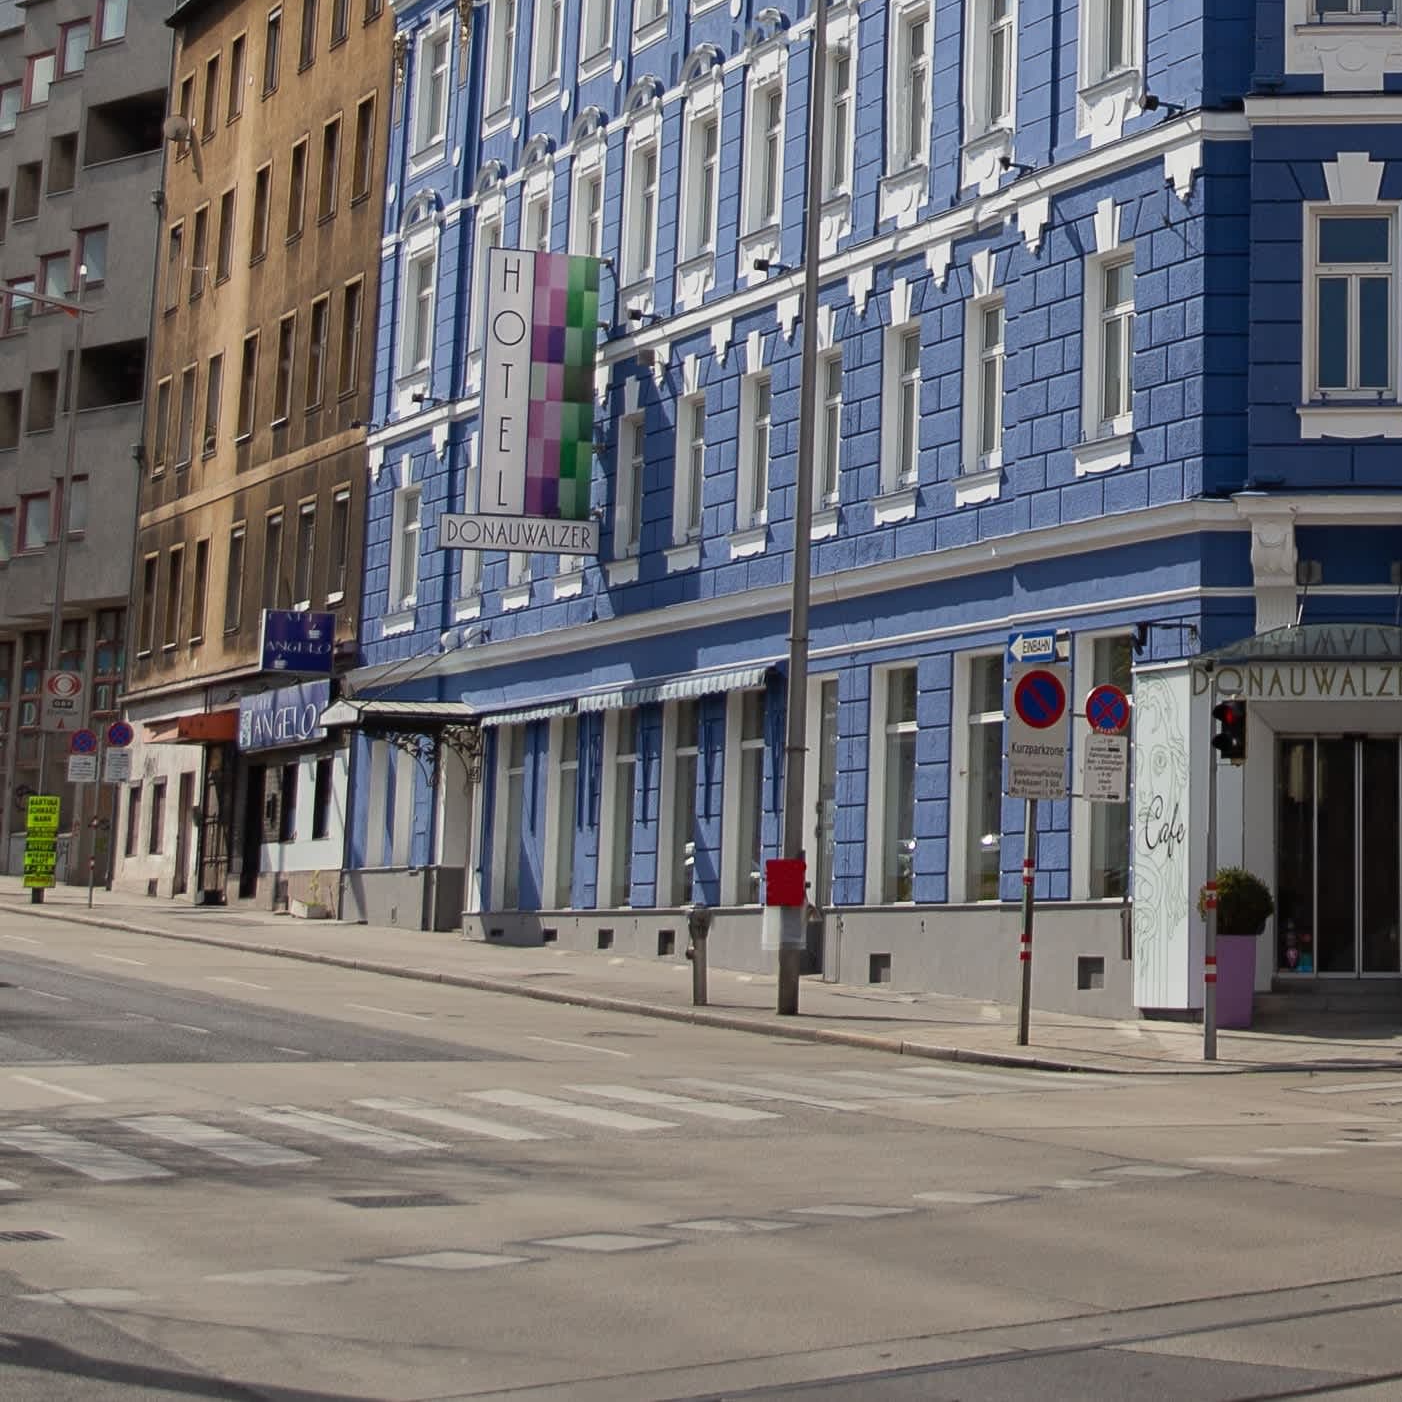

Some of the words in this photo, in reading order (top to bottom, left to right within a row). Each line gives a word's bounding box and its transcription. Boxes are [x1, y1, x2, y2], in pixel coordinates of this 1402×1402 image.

[493, 257, 526, 507] HOTEL
[447, 519, 592, 549] DONAUWALZER
[267, 641, 332, 654] ANGELO
[1023, 637, 1051, 654] EINBAHN
[253, 703, 317, 742] ANGELO
[1011, 742, 1065, 756] Kurzparkzone
[1145, 794, 1185, 858] Cafe
